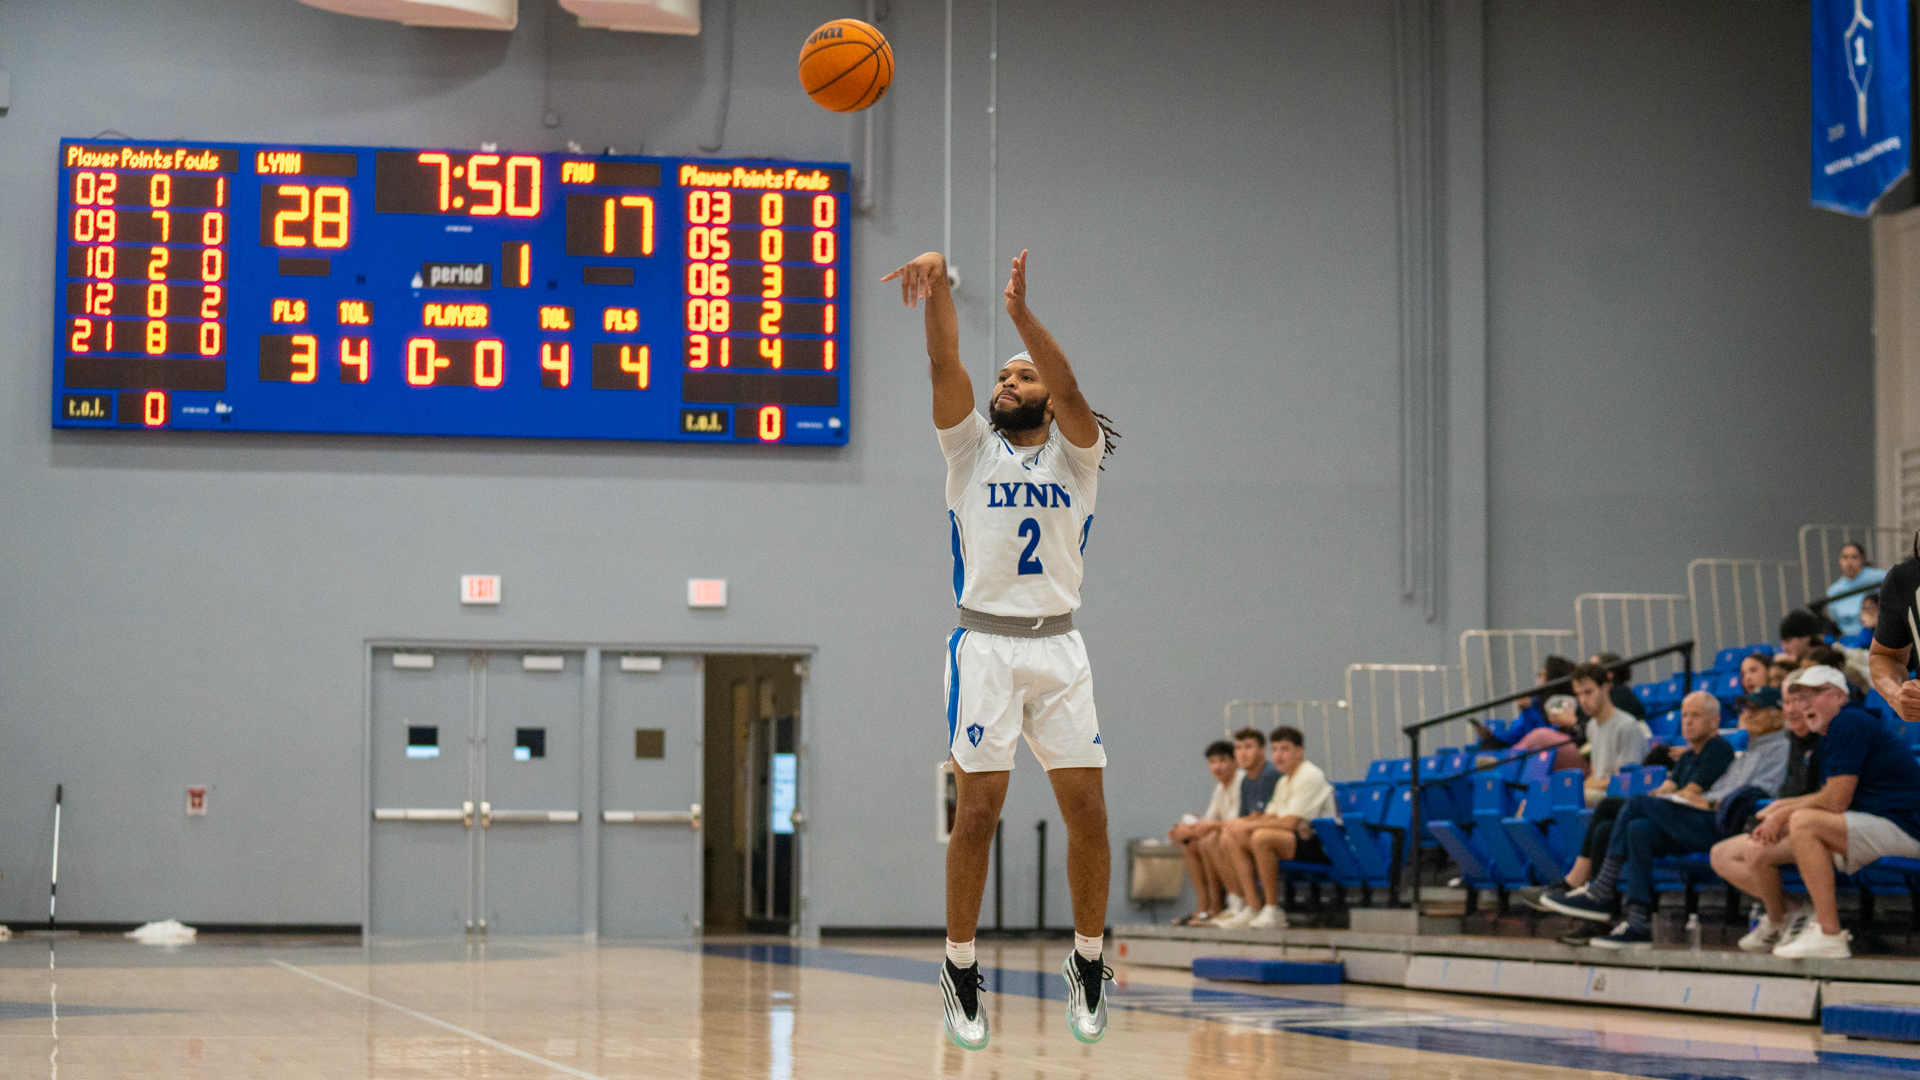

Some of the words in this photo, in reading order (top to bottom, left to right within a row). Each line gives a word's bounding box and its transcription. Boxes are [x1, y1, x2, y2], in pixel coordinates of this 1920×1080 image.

[1854, 35, 1867, 67] 1
[67, 146, 120, 168] Player
[120, 147, 174, 170] Points
[174, 149, 219, 171] Fouls
[75, 171, 117, 206] 02
[149, 173, 171, 208] 0
[216, 177, 224, 208] 1
[417, 153, 541, 217] 7:50
[680, 165, 733, 187] Player
[732, 167, 785, 189] Points
[784, 169, 830, 191] Fouls
[74, 208, 116, 243] 09
[151, 210, 170, 243] 7
[202, 211, 223, 246] 0
[274, 185, 349, 248] 28
[604, 195, 654, 255] 17
[688, 190, 731, 225] 03
[760, 192, 783, 227] 0
[813, 194, 835, 229] 0
[86, 245, 115, 280] 10
[147, 246, 169, 281] 2
[201, 248, 223, 282] 0
[688, 226, 731, 261] 05
[760, 228, 783, 263] 0
[813, 230, 835, 264] 0
[430, 264, 484, 287] period
[519, 243, 530, 286] 1
[688, 262, 730, 297] 06
[762, 264, 783, 299] 3
[825, 268, 834, 298] 1
[85, 281, 114, 316] 12
[147, 283, 168, 318] 0
[200, 284, 222, 319] 2
[273, 299, 306, 323] FLS
[339, 301, 370, 325] TOL
[424, 303, 488, 328] PLAYER
[540, 306, 571, 330] TOL
[687, 298, 730, 333] 08
[760, 300, 782, 335] 2
[825, 304, 834, 334] 1
[71, 318, 113, 353] 21
[146, 319, 167, 355] 8
[200, 321, 221, 356] 0
[604, 308, 638, 332] FLS
[290, 335, 317, 383] 3
[340, 338, 369, 382] 4
[474, 339, 503, 387] 0
[541, 343, 570, 387] 4
[620, 345, 649, 389] 4
[689, 334, 730, 369] 31
[759, 337, 782, 369] 4
[824, 340, 834, 370] 1
[69, 397, 105, 416] t.o.l.
[144, 391, 165, 426] 0
[686, 412, 722, 431] t.o.l.
[759, 406, 781, 441] 0
[987, 482, 1071, 508] LYNN
[1017, 517, 1044, 576] 2
